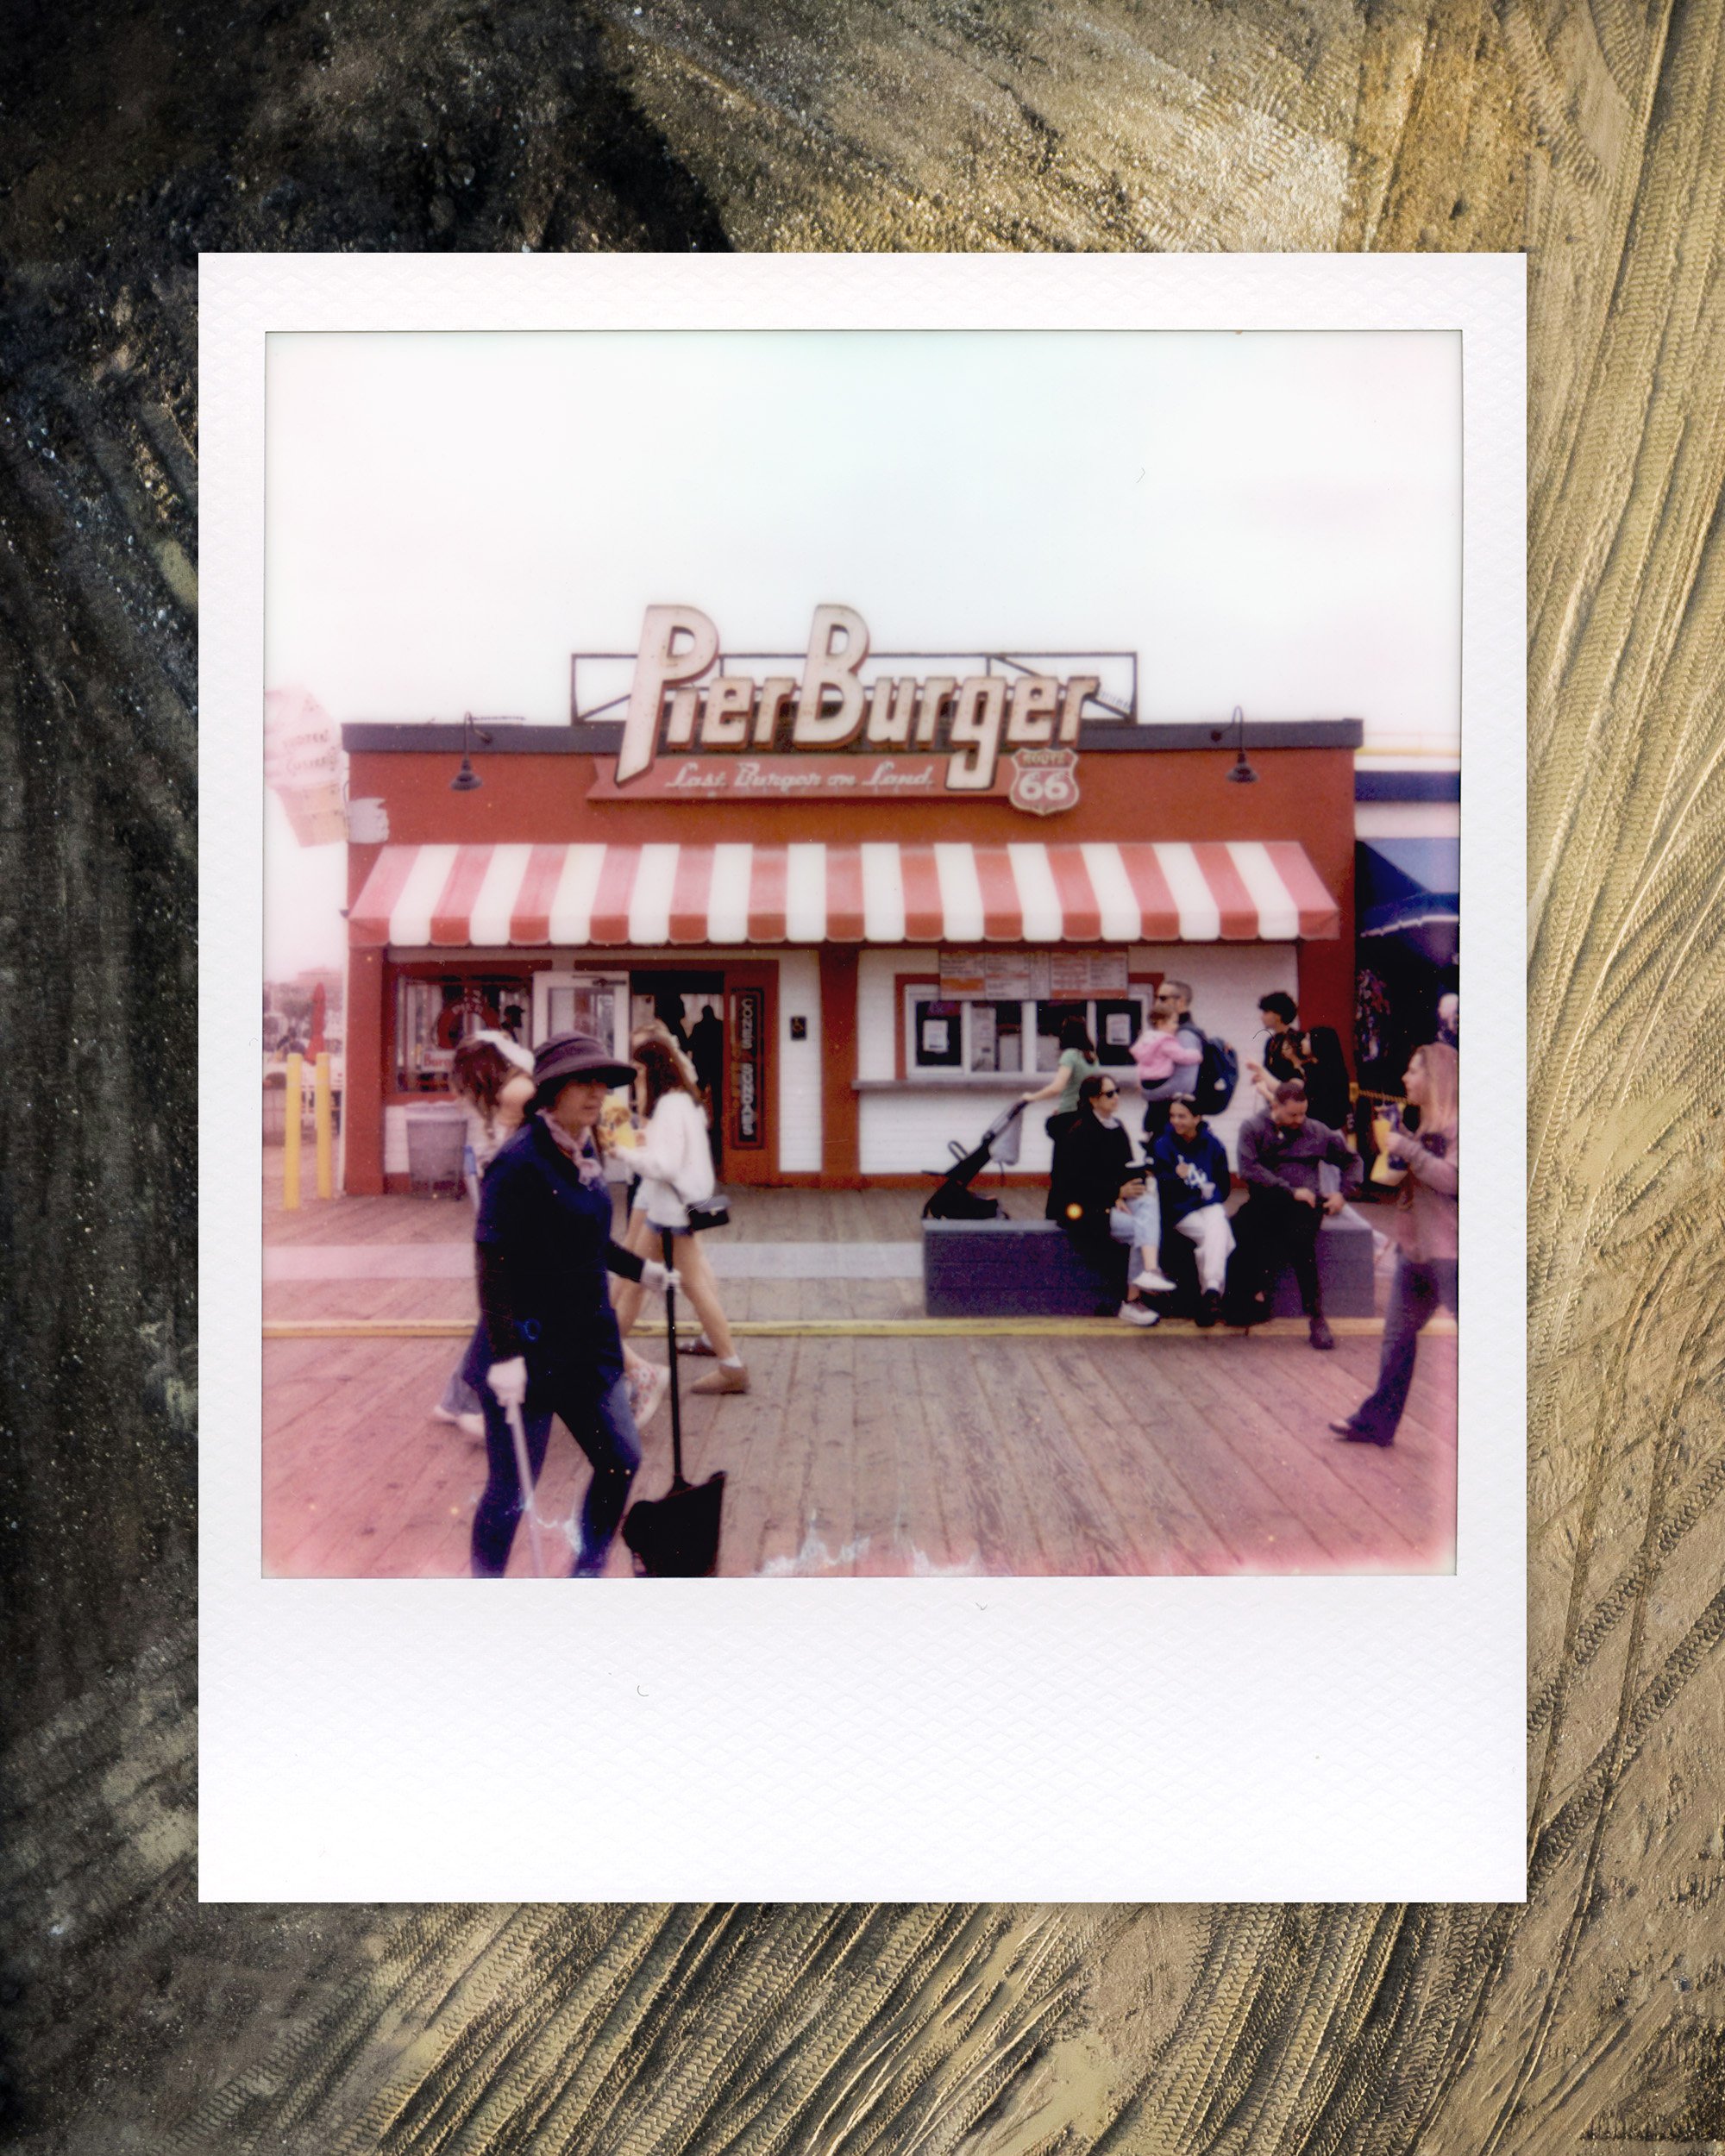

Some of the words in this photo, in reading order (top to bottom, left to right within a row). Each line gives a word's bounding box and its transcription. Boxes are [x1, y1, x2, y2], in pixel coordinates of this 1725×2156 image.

[1022, 751, 1065, 765] ROUTE
[665, 761, 727, 787] Last
[734, 761, 822, 793] Burger
[828, 773, 856, 787] on
[861, 760, 934, 787] Land
[1019, 771, 1069, 800] 66
